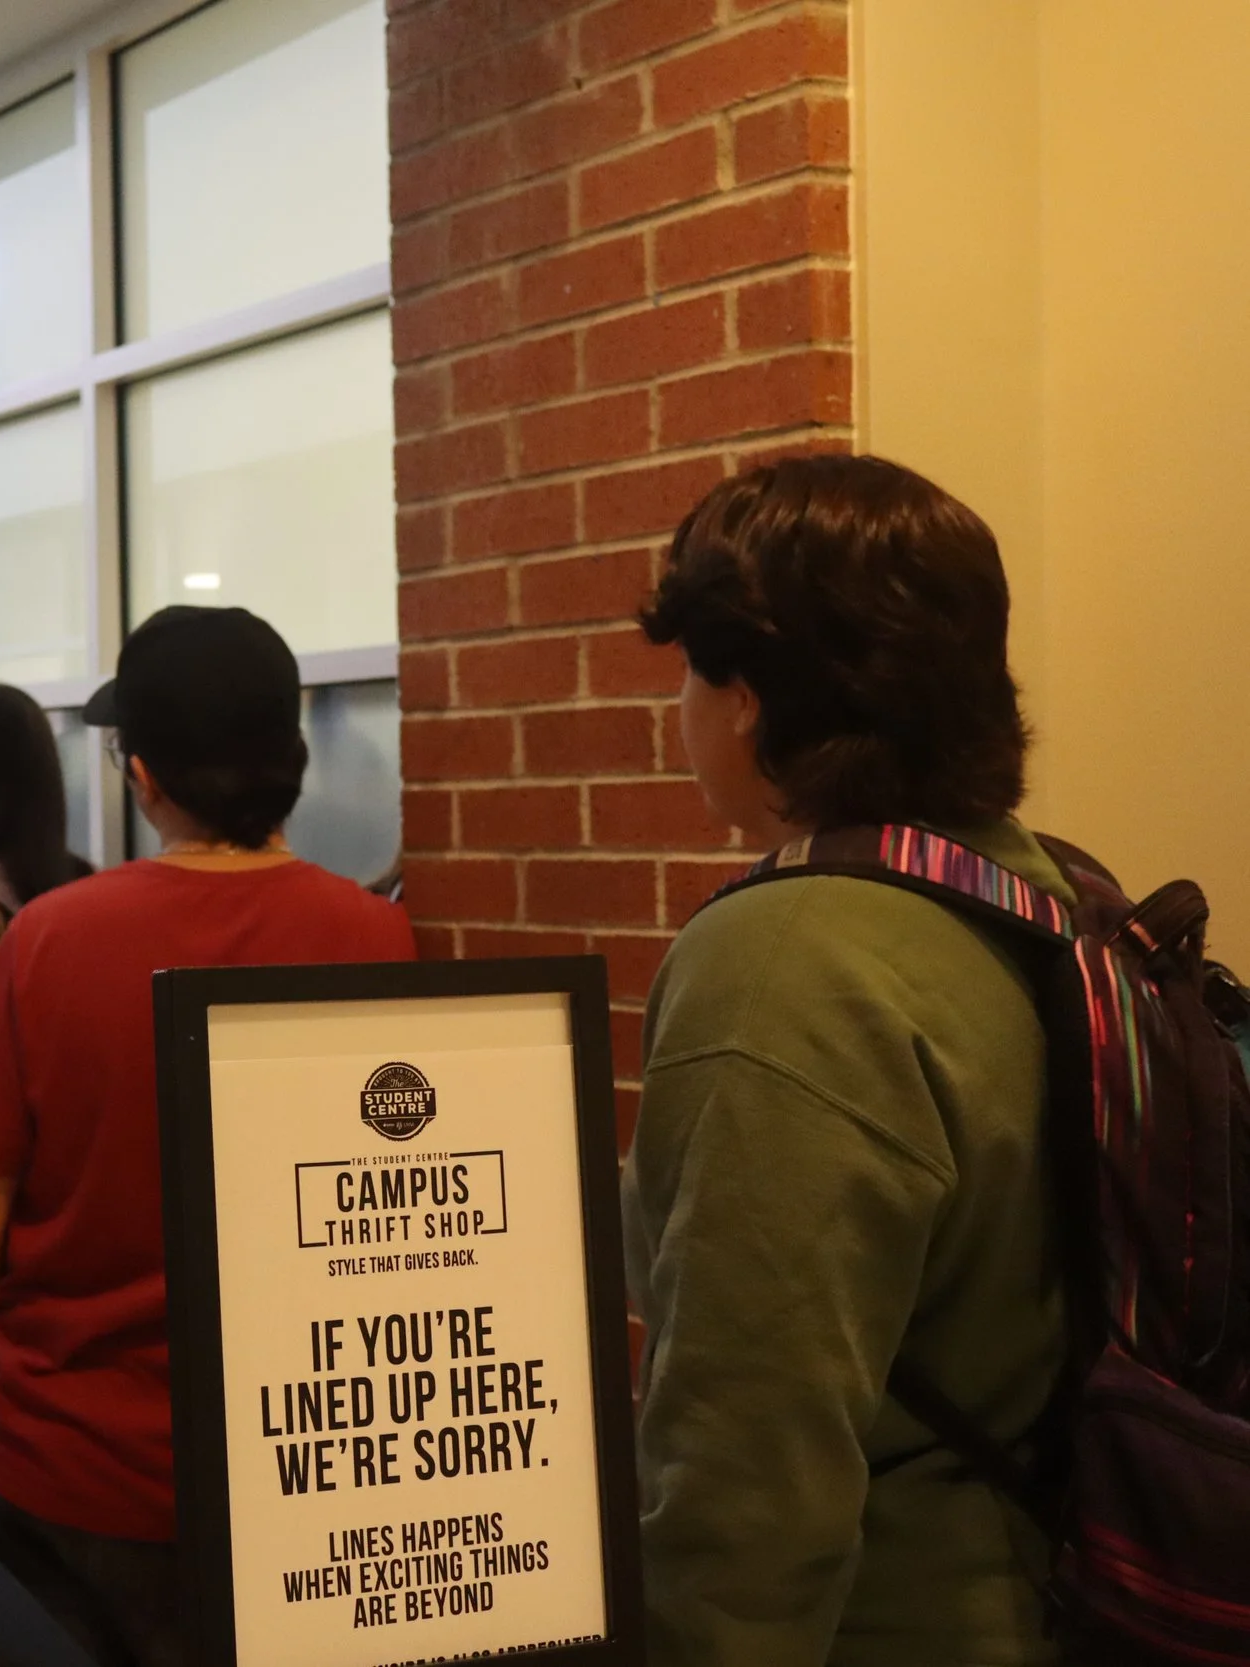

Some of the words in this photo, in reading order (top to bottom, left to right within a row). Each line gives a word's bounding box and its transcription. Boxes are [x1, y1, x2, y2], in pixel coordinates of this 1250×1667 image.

[365, 1090, 432, 1105] STUDENT
[368, 1102, 426, 1116] CENTRE
[352, 1158, 368, 1166] THE
[372, 1154, 411, 1165] STUDENT
[416, 1152, 448, 1162] CENTRE
[336, 1164, 469, 1213] CAMPUS
[325, 1215, 411, 1247] THRIFT
[424, 1209, 484, 1239] SHOP
[328, 1257, 367, 1277] STYLE
[369, 1255, 401, 1274] THAT
[404, 1252, 440, 1271] GIVES
[442, 1248, 479, 1268] BACK.
[311, 1320, 344, 1373] IF
[357, 1306, 496, 1368] YOU'RE
[261, 1376, 375, 1438] LINED
[388, 1371, 436, 1424] UP
[449, 1359, 558, 1418] HERE,
[275, 1433, 401, 1496] WE'RE
[413, 1418, 549, 1481] SORRY.
[329, 1526, 395, 1563] LINES
[402, 1513, 504, 1554] HAPPENS
[283, 1565, 352, 1603] WHEN
[359, 1551, 463, 1594] EXCITING
[469, 1540, 549, 1579] THINGS
[353, 1593, 398, 1629] ARE
[404, 1581, 494, 1622] BEYOND
